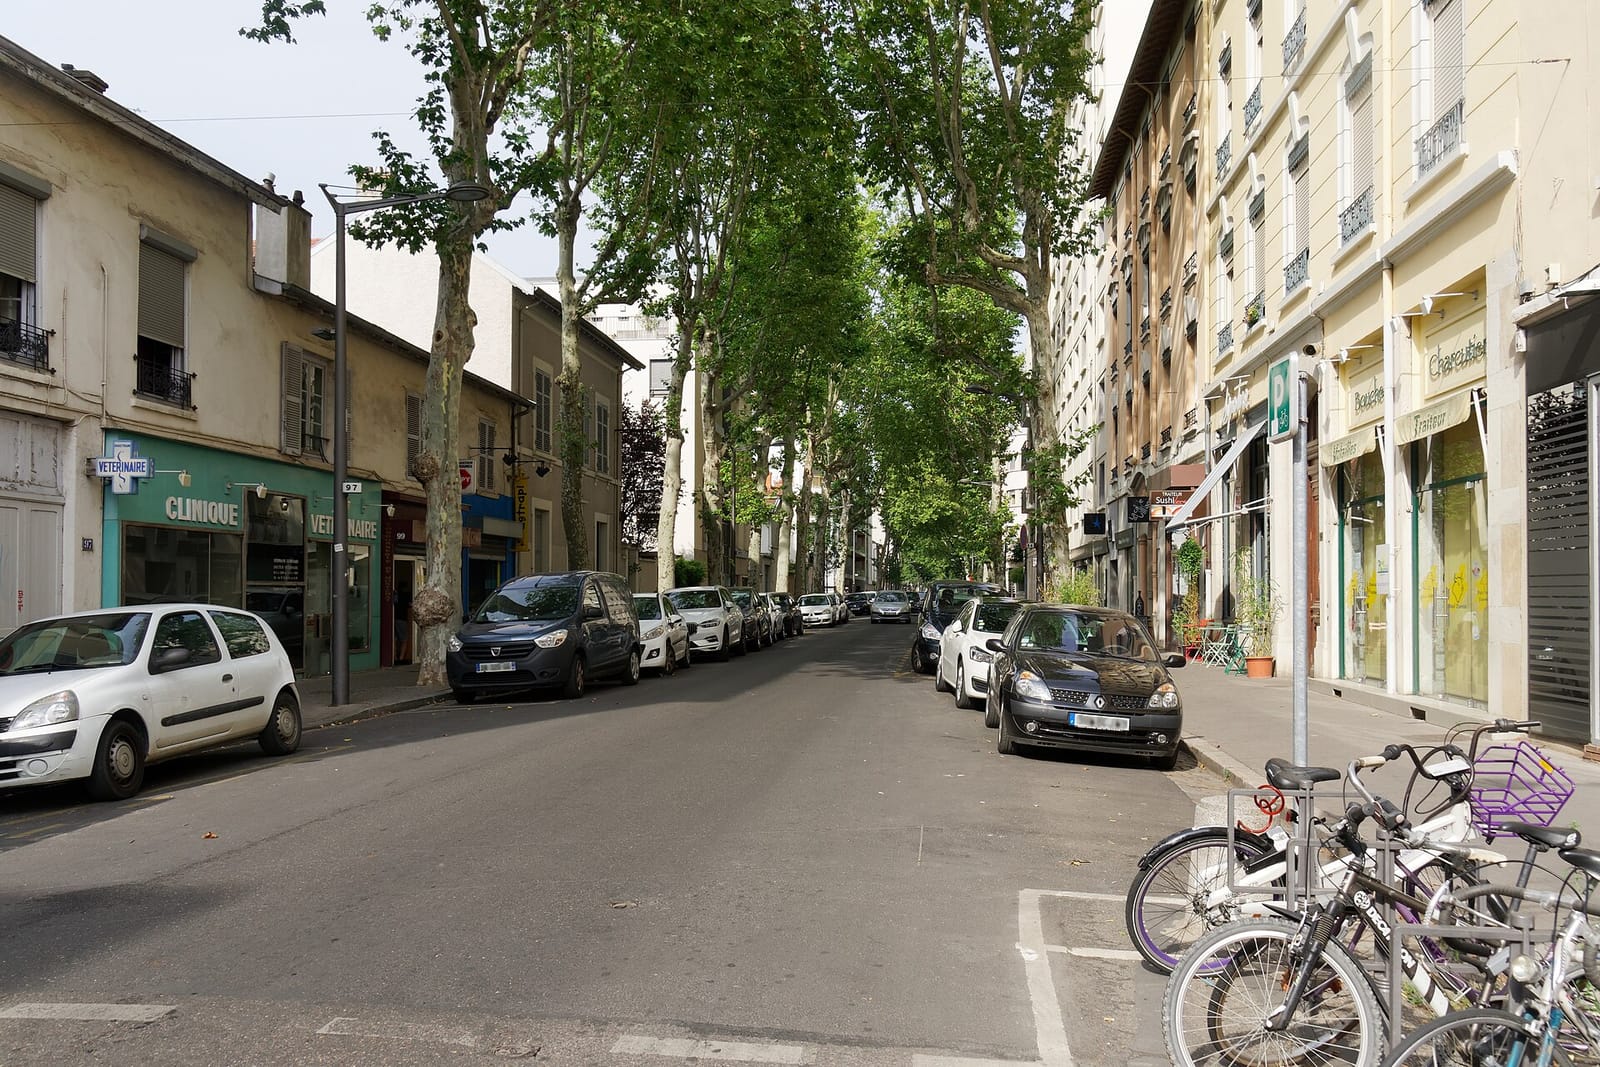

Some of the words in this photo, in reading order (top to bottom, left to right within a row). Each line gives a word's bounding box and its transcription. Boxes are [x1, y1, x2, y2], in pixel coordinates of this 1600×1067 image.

[1354, 376, 1385, 411] Bouche
[1413, 411, 1447, 438] Traiteur
[98, 461, 147, 473] VETERINAIRE
[165, 496, 239, 526] CLINIQUE
[1155, 496, 1175, 504] Sushi
[311, 514, 377, 539] VETNAIRE
[84, 540, 92, 549] 97
